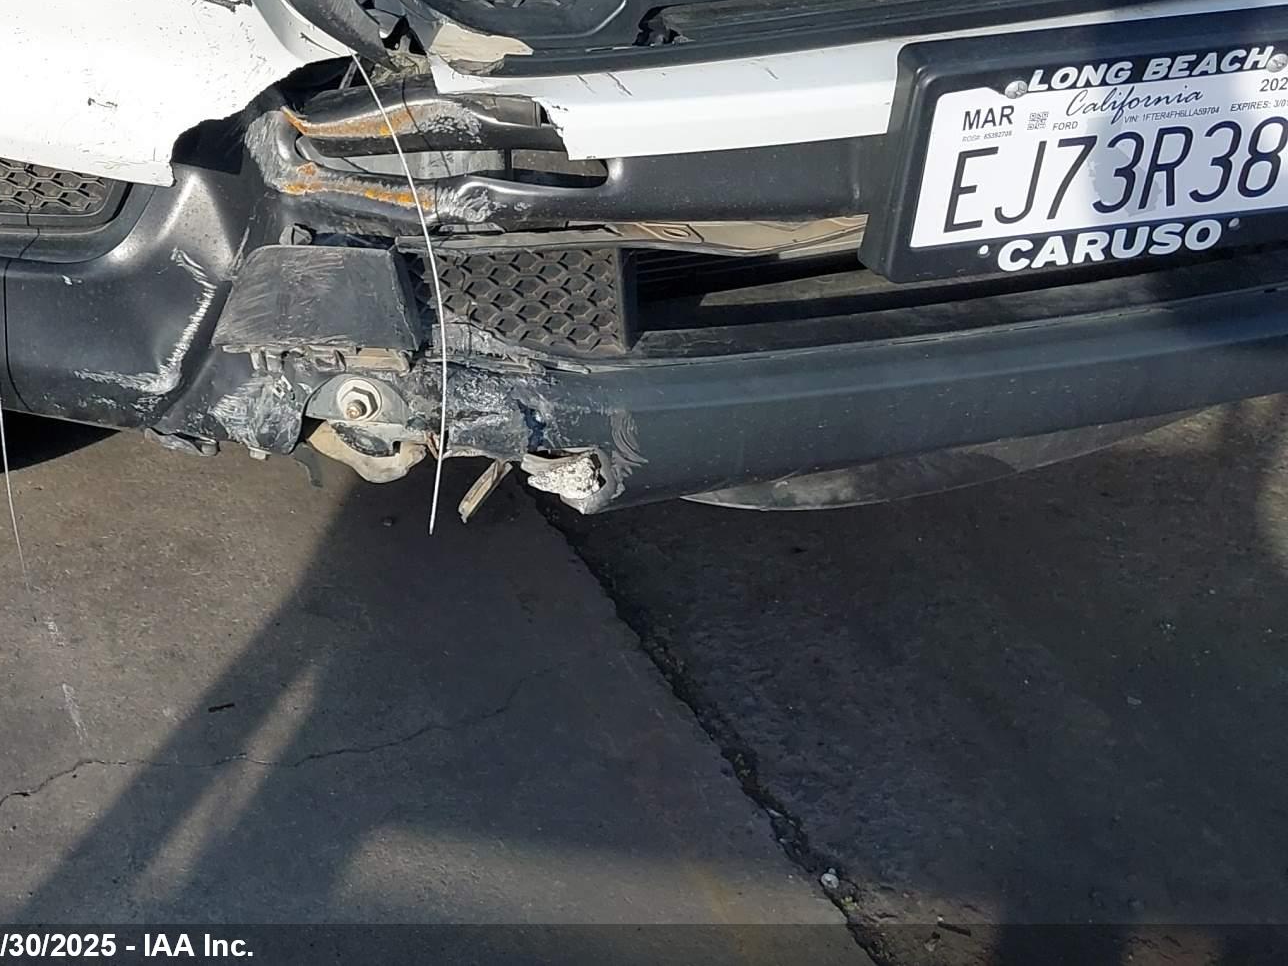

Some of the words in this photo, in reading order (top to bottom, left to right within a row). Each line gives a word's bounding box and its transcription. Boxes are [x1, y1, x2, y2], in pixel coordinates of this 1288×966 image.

[1026, 61, 1133, 92] LONG
[1142, 46, 1274, 82] BEACH
[962, 105, 1015, 131] MAR
[1066, 85, 1203, 125] California
[1230, 100, 1272, 112] EXPIRES:
[1052, 120, 1079, 131] FORD
[943, 116, 1288, 233] EJ73R38
[996, 219, 1222, 273] CARUSO
